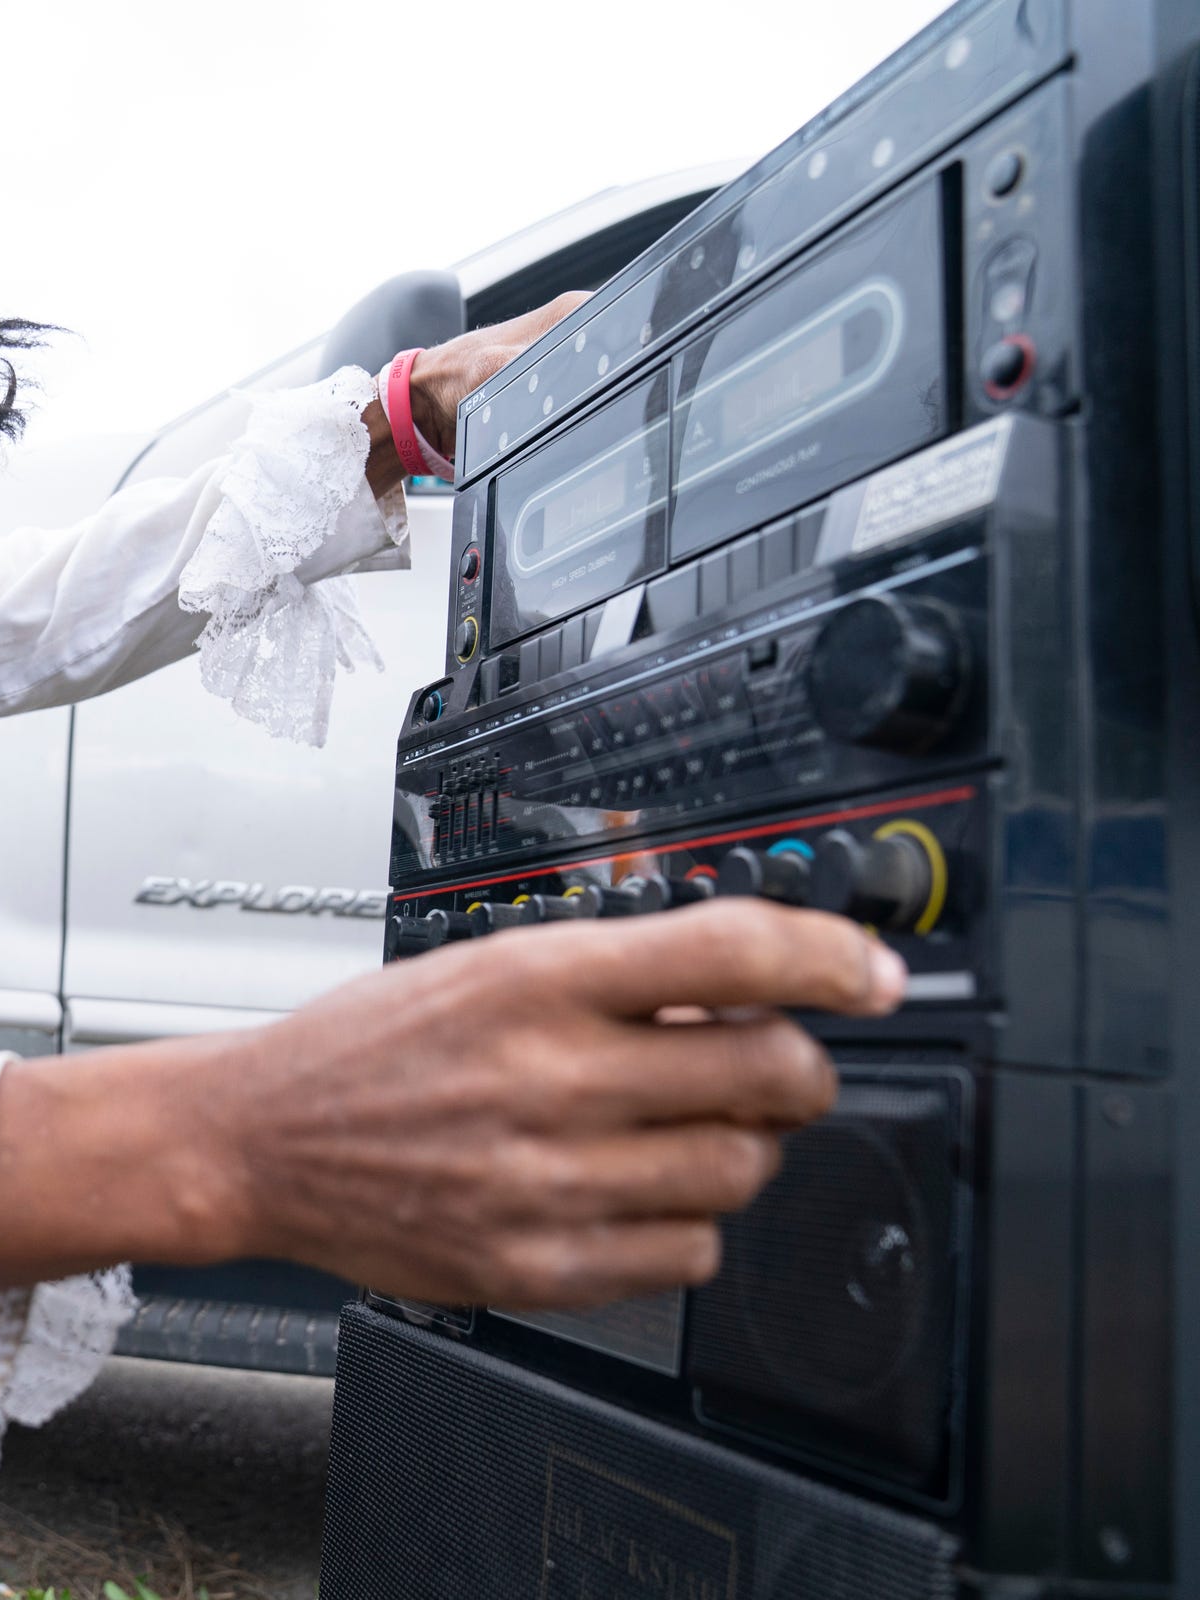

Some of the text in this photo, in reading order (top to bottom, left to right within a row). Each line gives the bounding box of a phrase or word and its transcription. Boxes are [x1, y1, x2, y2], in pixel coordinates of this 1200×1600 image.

[465, 388, 486, 412] CPX
[692, 421, 705, 440] A
[551, 550, 617, 590] HIGH SPEED DUBBING
[134, 875, 388, 919] EXPLORE
